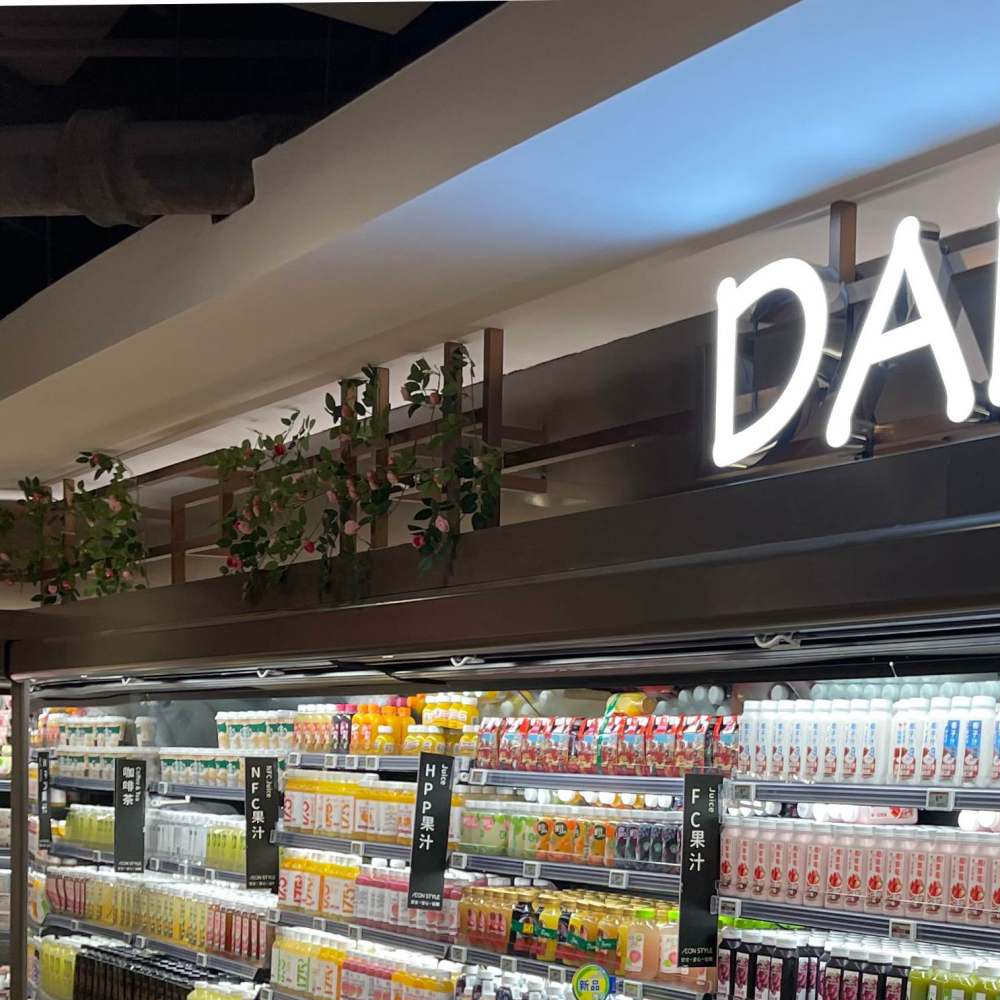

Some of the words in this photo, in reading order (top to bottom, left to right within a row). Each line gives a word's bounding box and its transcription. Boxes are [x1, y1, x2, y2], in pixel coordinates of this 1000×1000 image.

[122, 766, 135, 806] 咖啡茶
[440, 764, 449, 786] Juice
[251, 766, 264, 840] NFC果汁
[419, 763, 436, 851] HPP果汁
[708, 787, 716, 813] Juice
[689, 788, 706, 872] FC果汁
[579, 979, 600, 992] 新品
